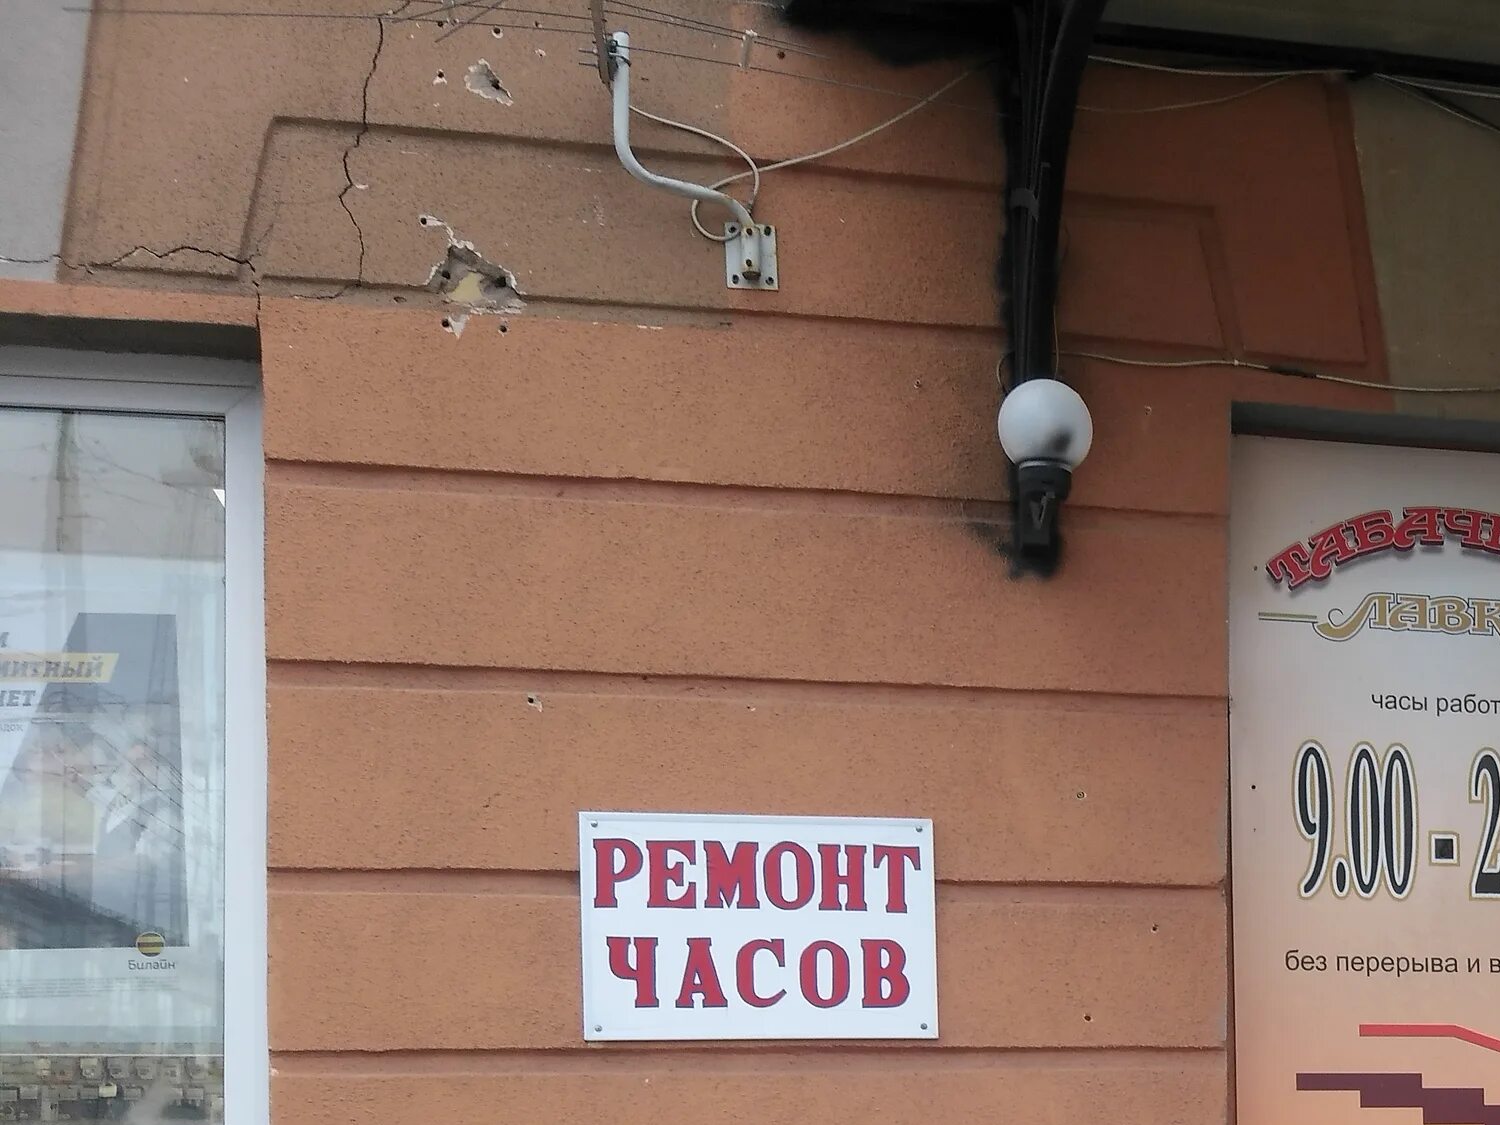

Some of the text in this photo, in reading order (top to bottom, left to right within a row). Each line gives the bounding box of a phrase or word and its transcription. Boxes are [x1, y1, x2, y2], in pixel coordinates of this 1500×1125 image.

[1371, 692, 1428, 713] часы
[1292, 739, 1418, 900] 9.00
[1428, 830, 1460, 866] -
[593, 838, 921, 914] РЕМОНТ
[128, 958, 176, 970] Билайн
[606, 936, 910, 1008] ЧАСОВ
[1284, 950, 1328, 974] без
[1335, 955, 1459, 979] перерыва
[1468, 958, 1481, 974] и
